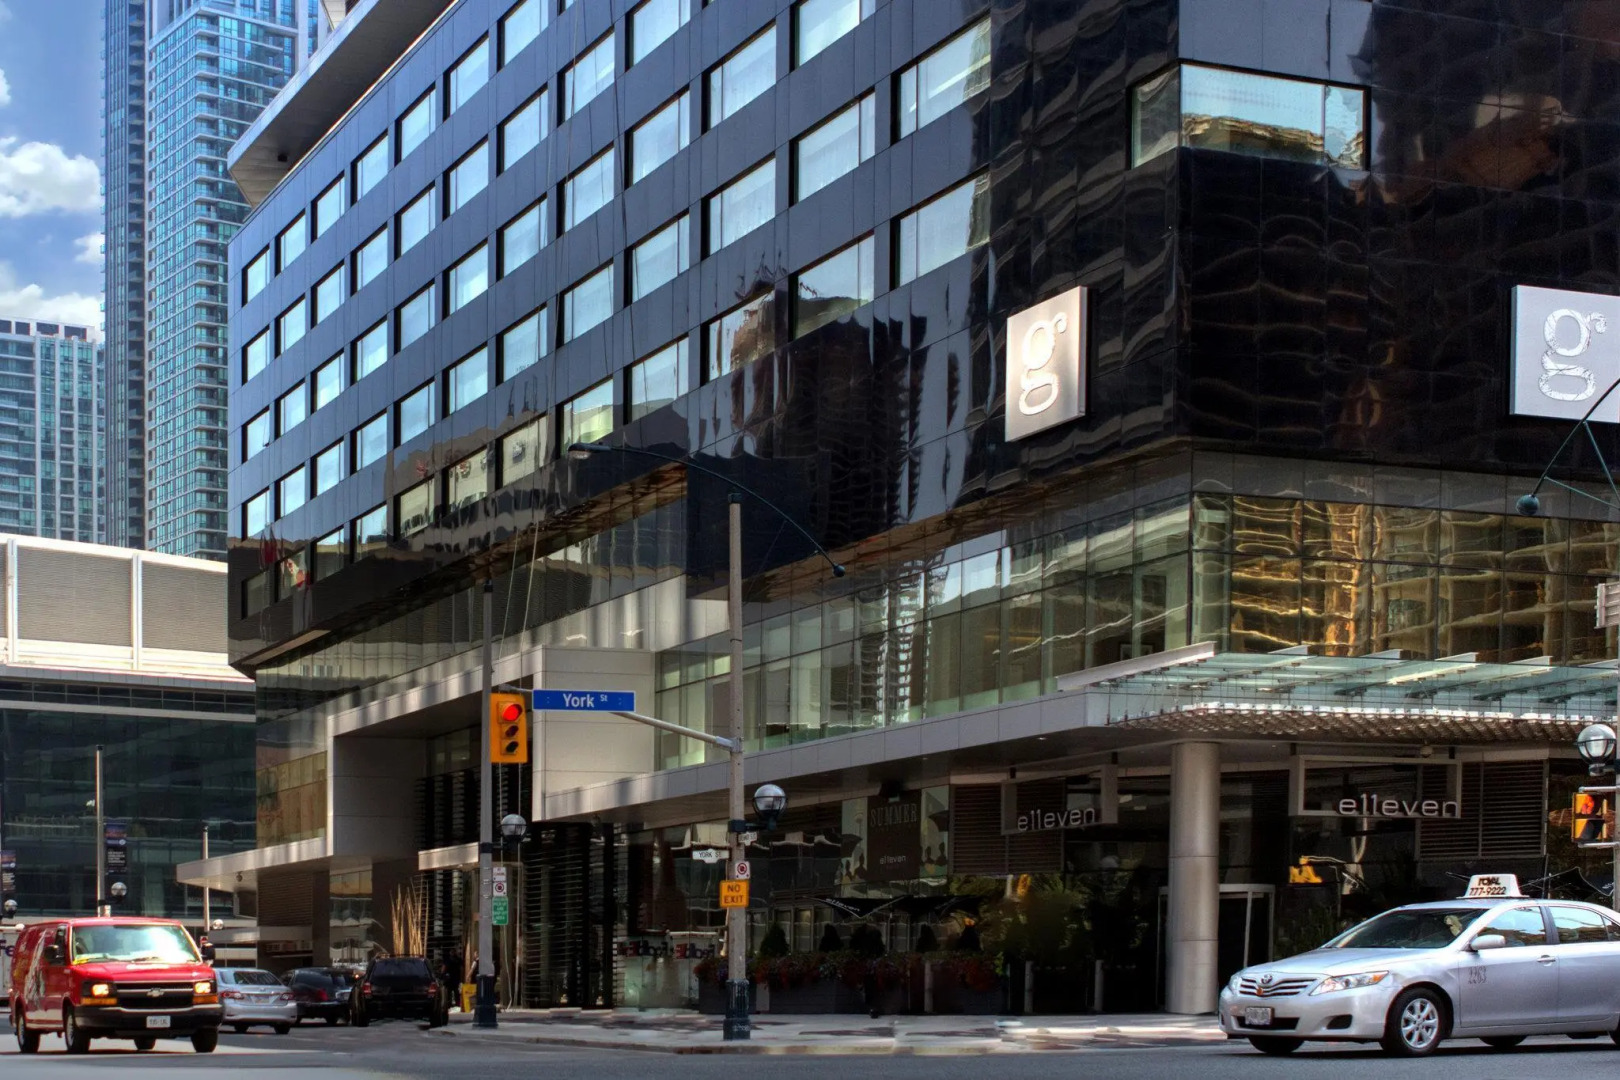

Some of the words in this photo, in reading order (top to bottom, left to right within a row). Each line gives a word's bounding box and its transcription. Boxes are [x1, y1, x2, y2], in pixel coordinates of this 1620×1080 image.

[562, 693, 595, 708] York
[600, 694, 608, 702] St
[870, 803, 917, 827] SUMMER
[727, 884, 740, 892] NO
[1469, 886, 1507, 896] 777-9222
[724, 895, 743, 904] EXIT
